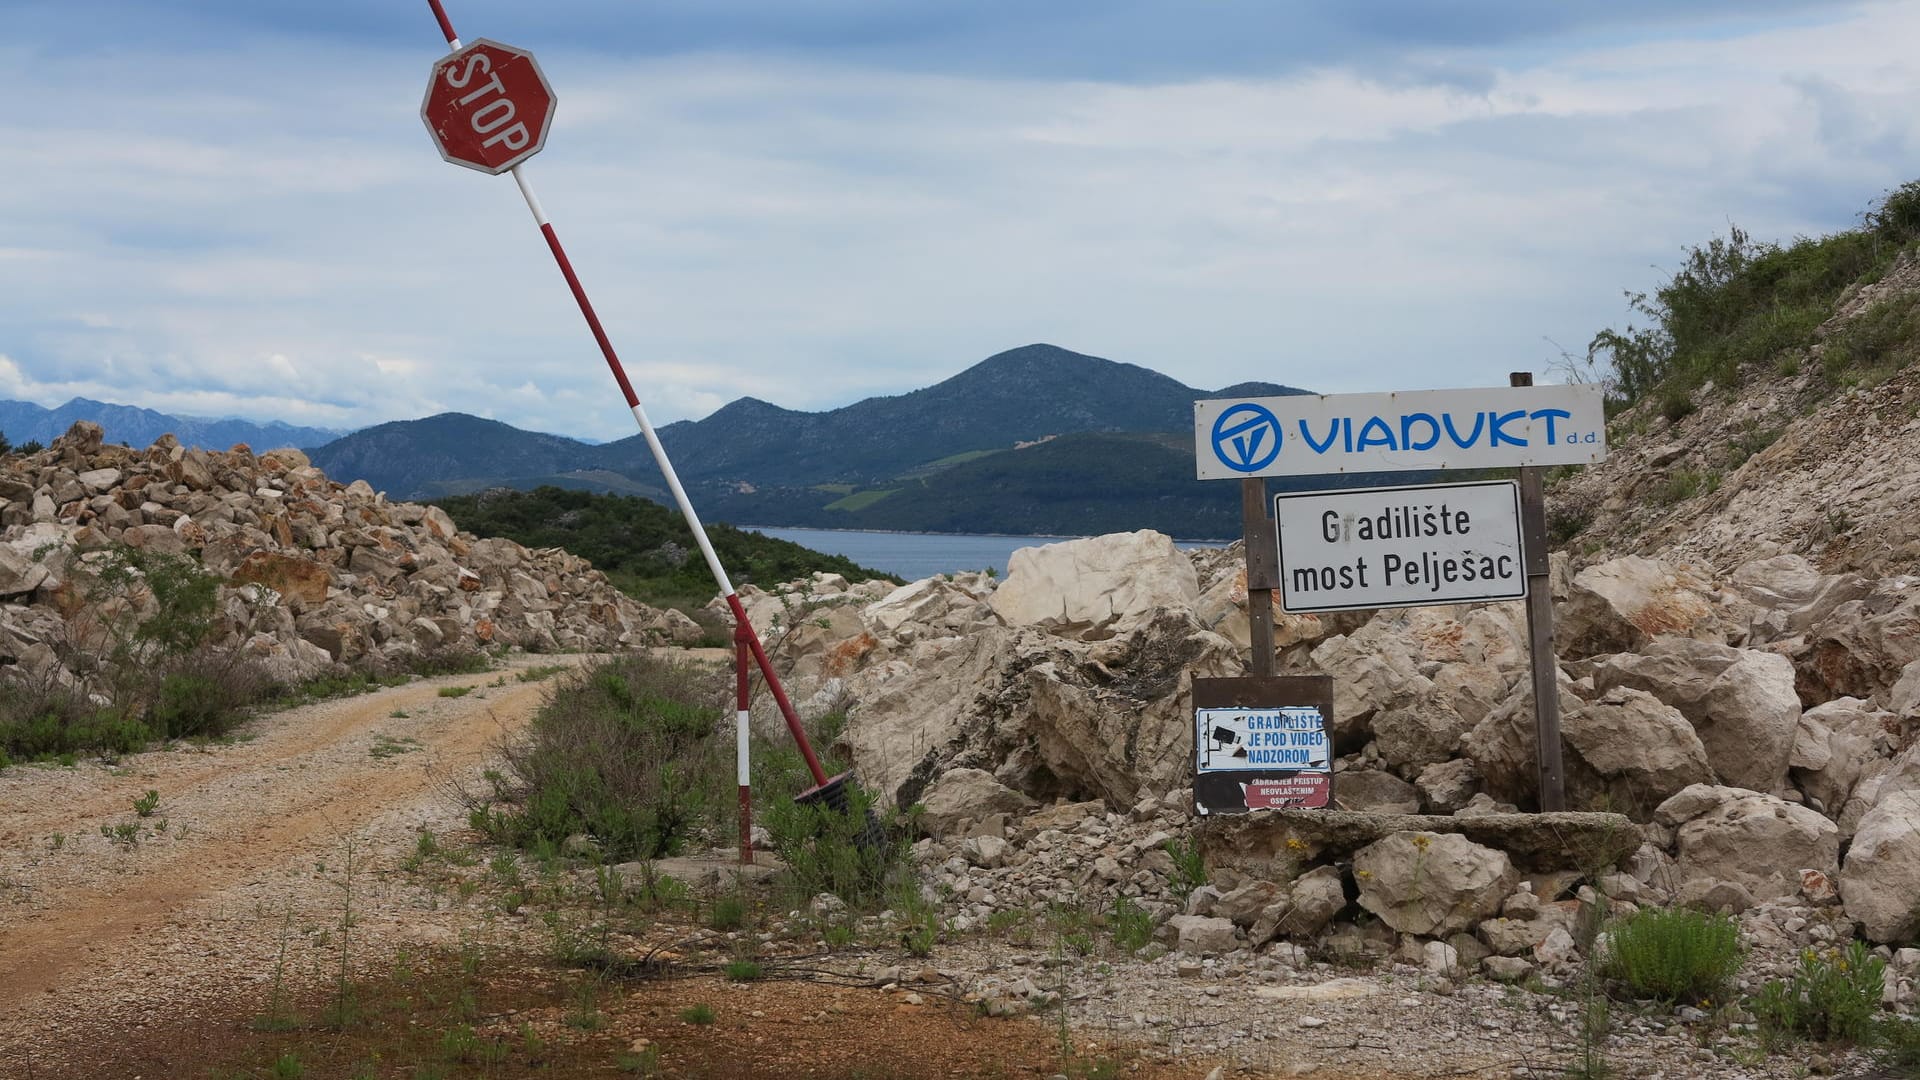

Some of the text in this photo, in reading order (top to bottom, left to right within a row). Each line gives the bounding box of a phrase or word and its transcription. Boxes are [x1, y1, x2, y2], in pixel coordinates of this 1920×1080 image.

[446, 53, 530, 151] STOP
[1299, 408, 1601, 454] VIADUKT d.d.
[1293, 550, 1513, 592] most Pelješac
[1248, 732, 1323, 747] JE POD VIDEO
[1248, 749, 1310, 763] NADZOROM
[1293, 777, 1324, 785] PRISTUP
